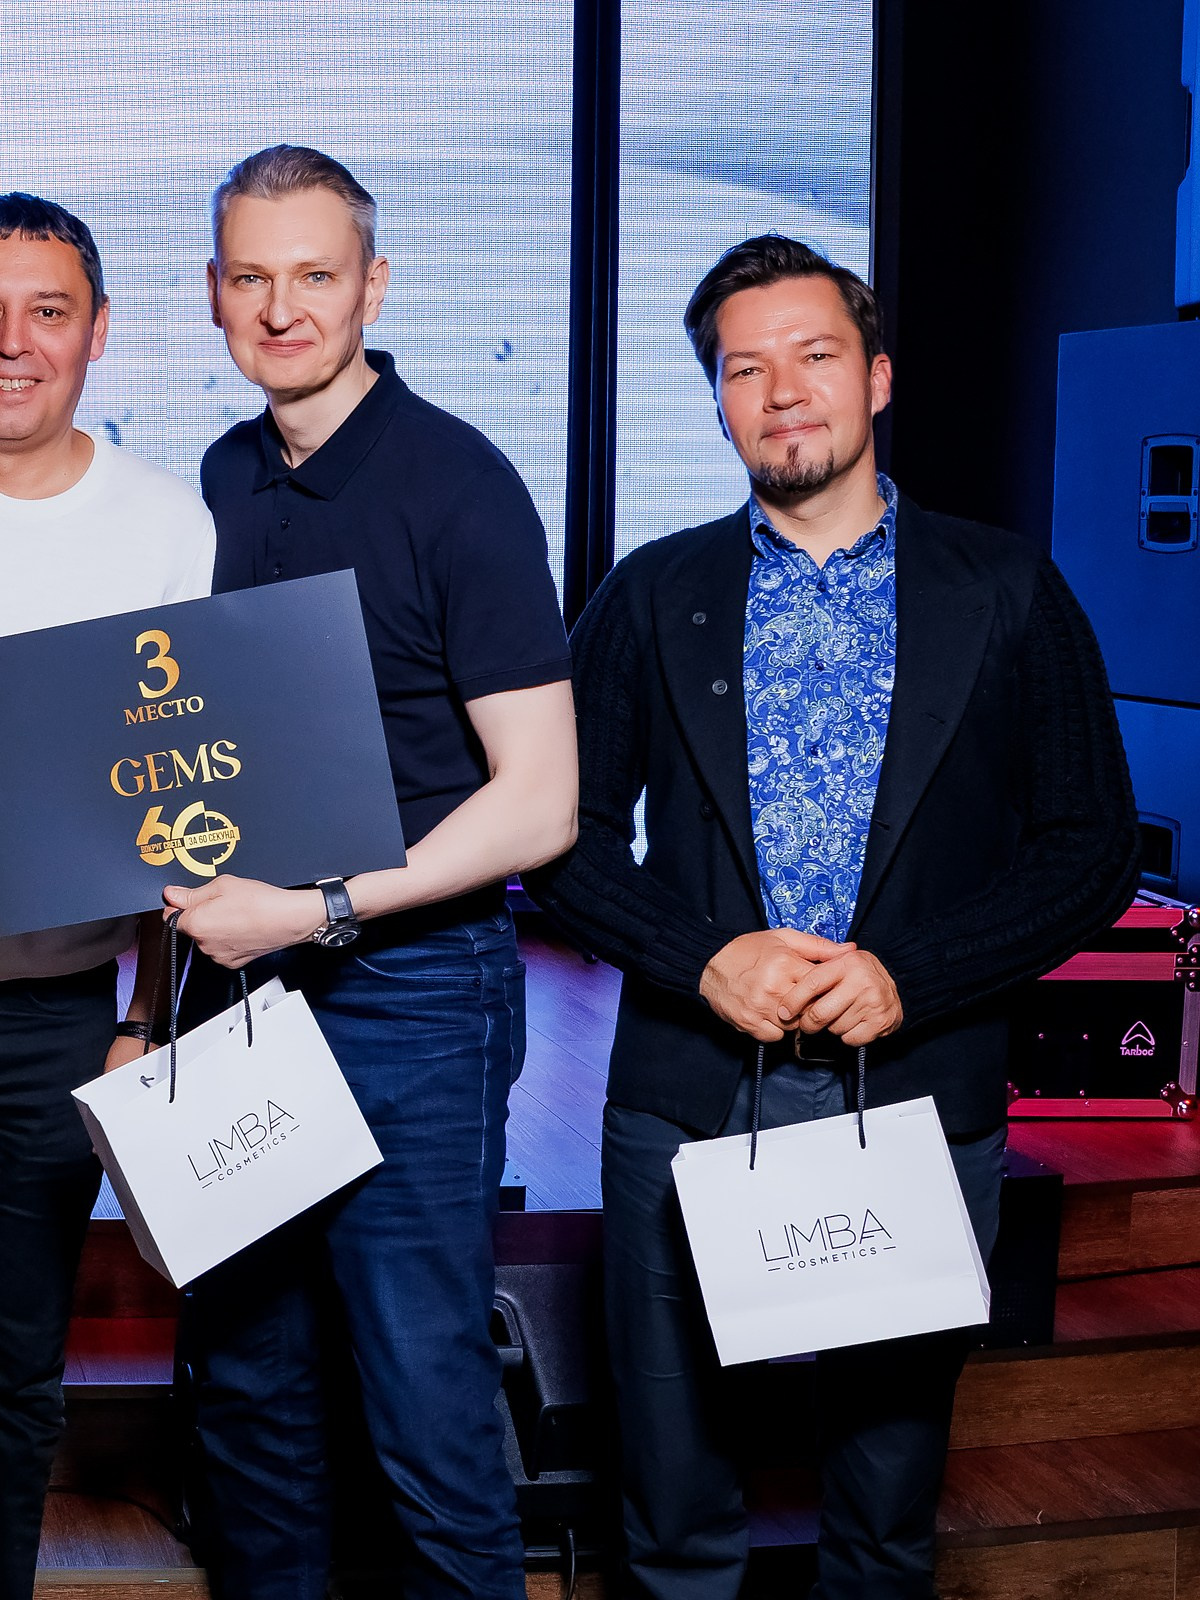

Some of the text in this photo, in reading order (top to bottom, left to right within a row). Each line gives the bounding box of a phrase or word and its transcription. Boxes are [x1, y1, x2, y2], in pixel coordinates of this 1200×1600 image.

[135, 629, 180, 698] 3
[124, 696, 204, 725] МЕСТО
[110, 740, 241, 796] GEMS
[140, 829, 235, 854] ВОКРУГ СВЕТА ЗА 60 СЕКУНД
[187, 1099, 295, 1181] LIMBA
[217, 1132, 287, 1181] COSMETICS
[758, 1208, 892, 1262] LIMBA
[787, 1246, 877, 1271] COSMETICS
